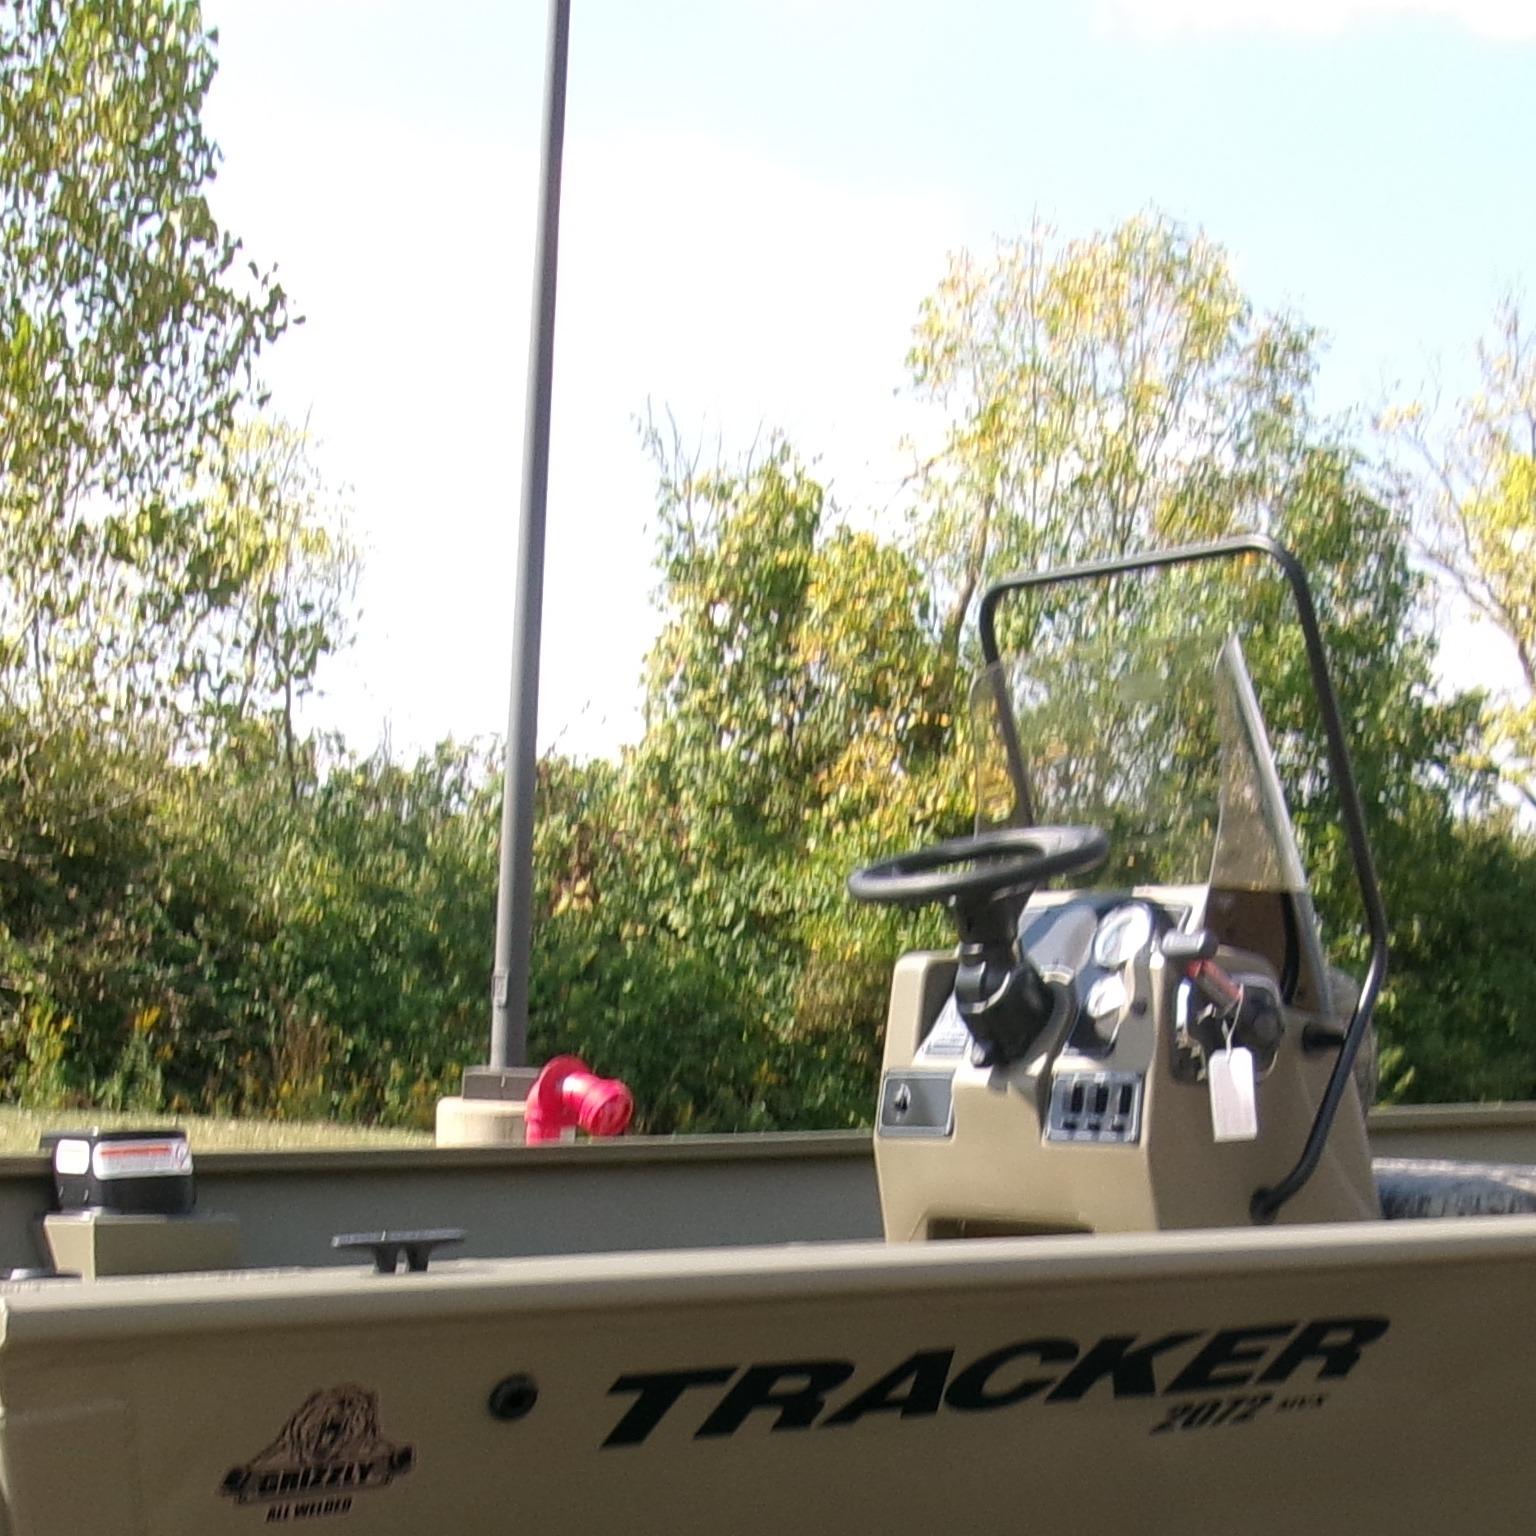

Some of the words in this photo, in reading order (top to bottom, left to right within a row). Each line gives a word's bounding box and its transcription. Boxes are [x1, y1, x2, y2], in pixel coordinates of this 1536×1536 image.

[599, 1315, 1390, 1450] TRACKER
[1149, 1391, 1274, 1435] 2072
[258, 1463, 373, 1492] GRIZZLY
